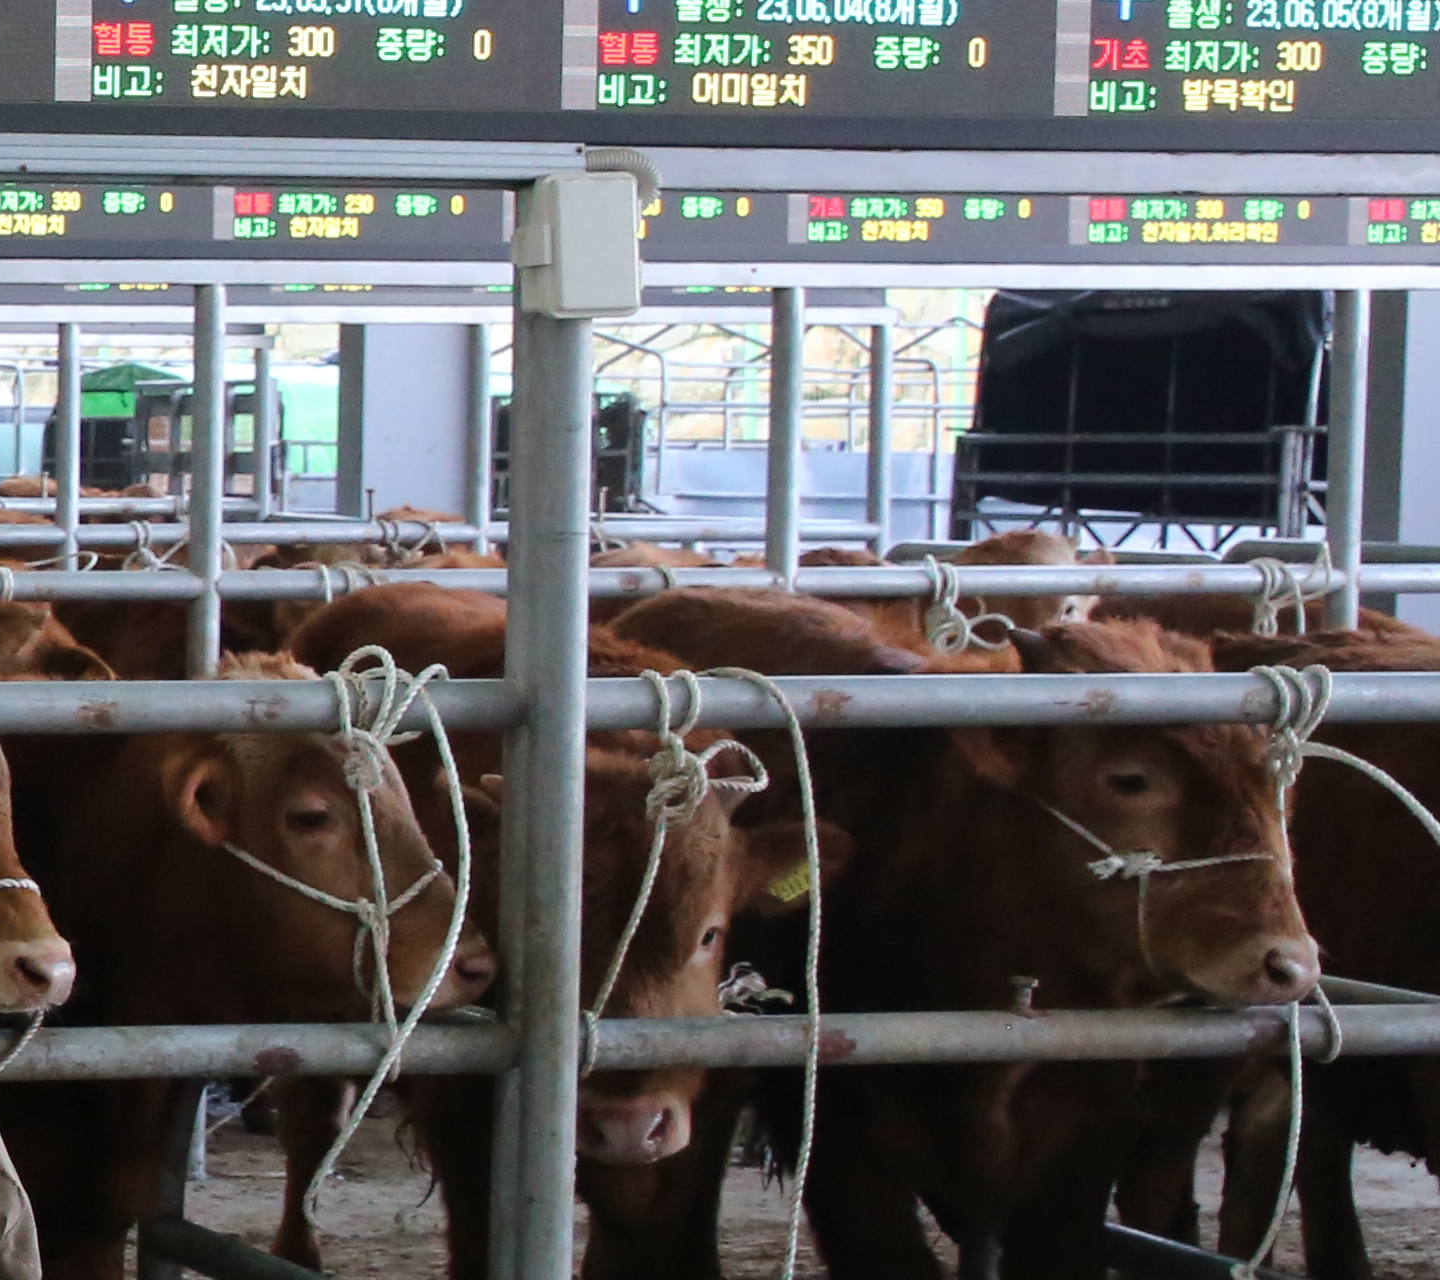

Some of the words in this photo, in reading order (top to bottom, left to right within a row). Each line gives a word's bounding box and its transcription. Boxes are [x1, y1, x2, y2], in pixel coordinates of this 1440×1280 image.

[92, 21, 156, 57] 혈통
[171, 24, 270, 58] 최저가:
[287, 26, 335, 58] 300
[376, 27, 445, 62] 중량:
[473, 29, 492, 60] 0
[596, 31, 660, 65] 혈통
[674, 33, 771, 67] 최저가:
[787, 34, 834, 66] 350
[873, 36, 940, 70] 중량:
[968, 37, 987, 68] 0
[1091, 38, 1151, 71] 기초
[1164, 40, 1259, 73] 최저가:
[1276, 40, 1322, 71] 300
[1361, 41, 1427, 75] 중량:
[93, 65, 163, 98] 비고:
[190, 64, 307, 99] 친자일치
[598, 74, 666, 107] 비고:
[692, 73, 807, 107] 어미일치
[1089, 80, 1157, 113] 비고:
[1182, 78, 1295, 112] 발목확인
[450, 194, 465, 215] 0
